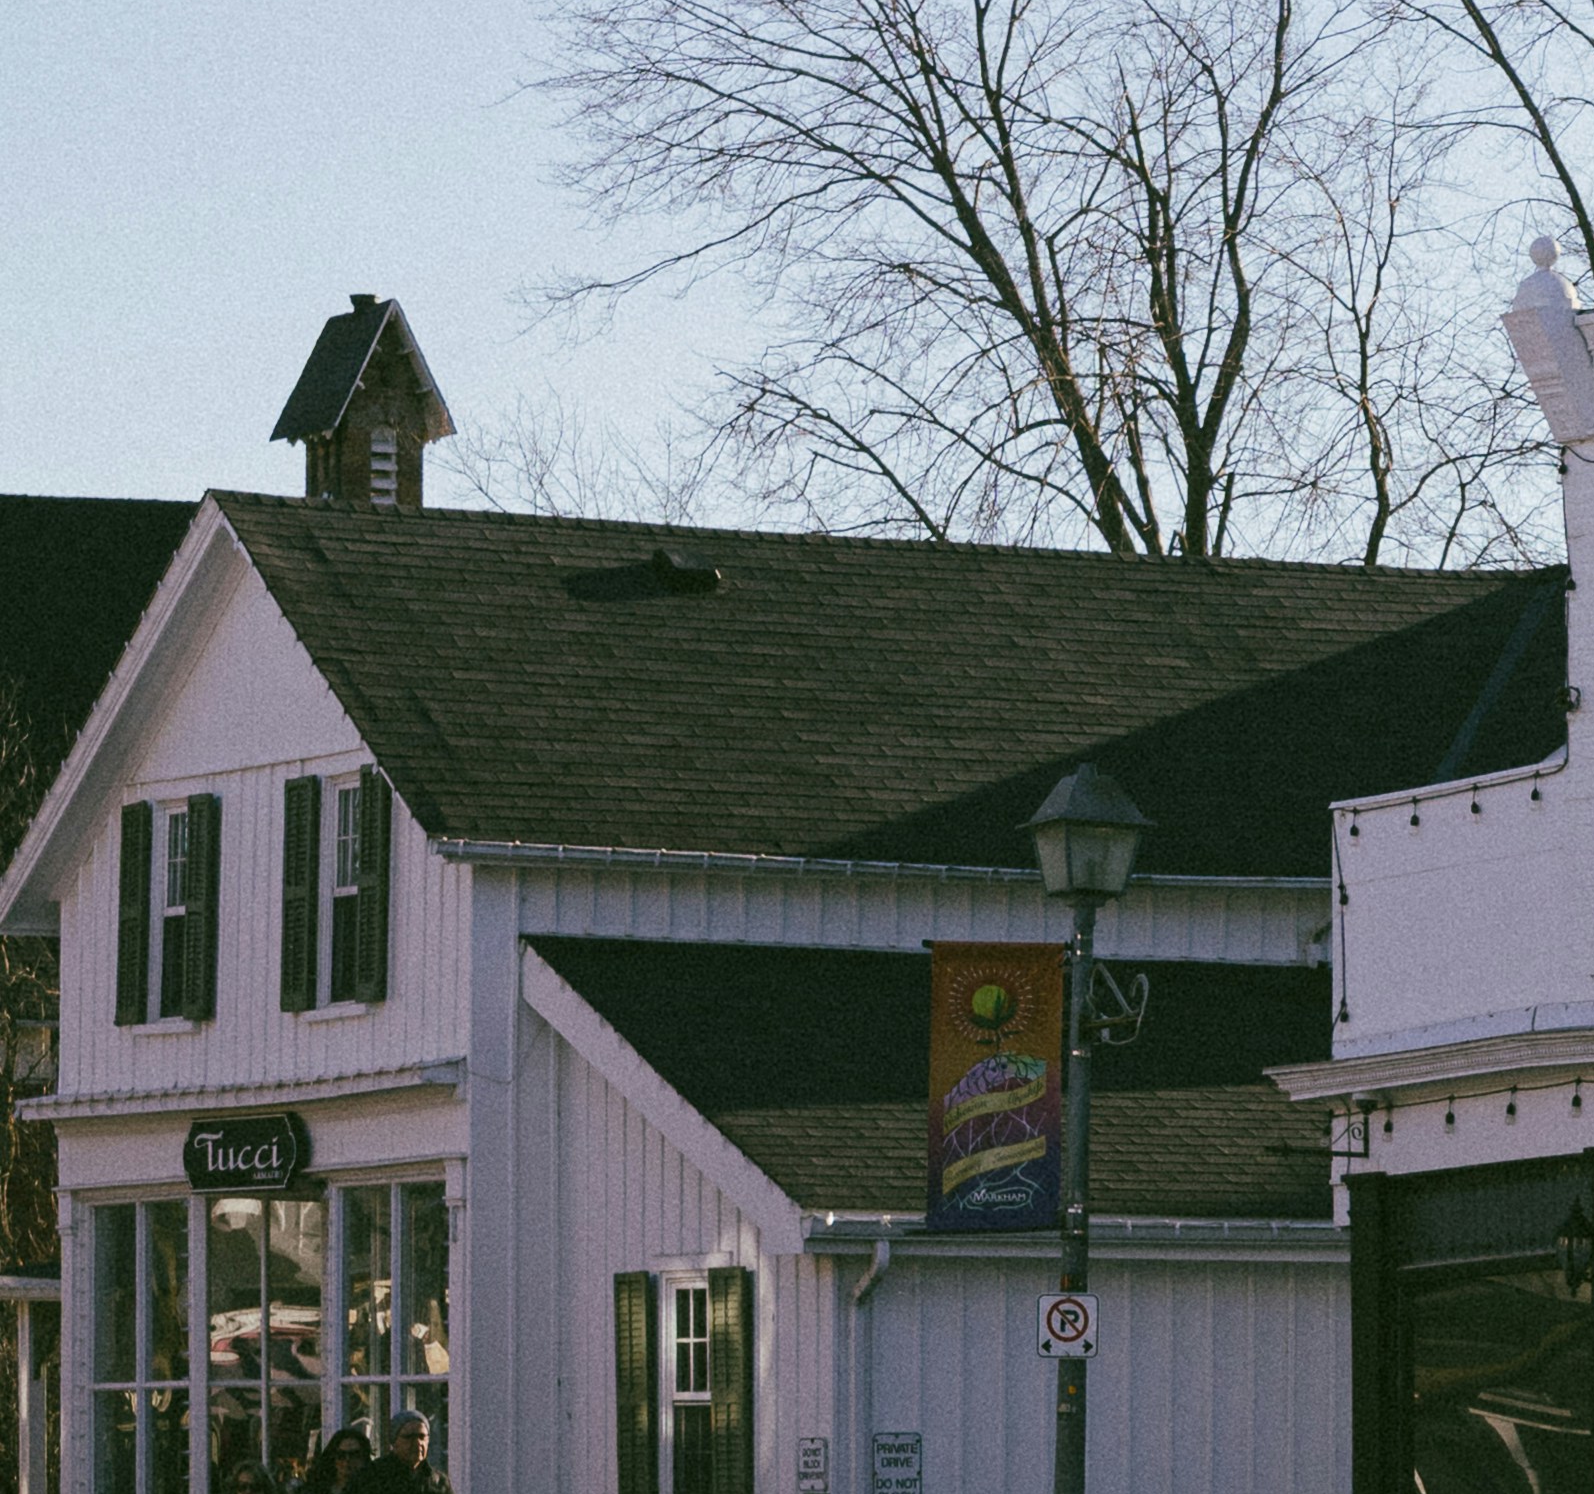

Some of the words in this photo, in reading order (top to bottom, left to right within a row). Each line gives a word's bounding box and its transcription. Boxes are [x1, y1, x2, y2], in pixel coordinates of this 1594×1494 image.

[194, 1130, 284, 1172] Tucci
[971, 1188, 1027, 1203] MARKHAM
[876, 1443, 919, 1455] PRIVATE
[881, 1456, 914, 1468] DRIVE
[876, 1478, 893, 1490] DO
[896, 1478, 919, 1490] NOT
